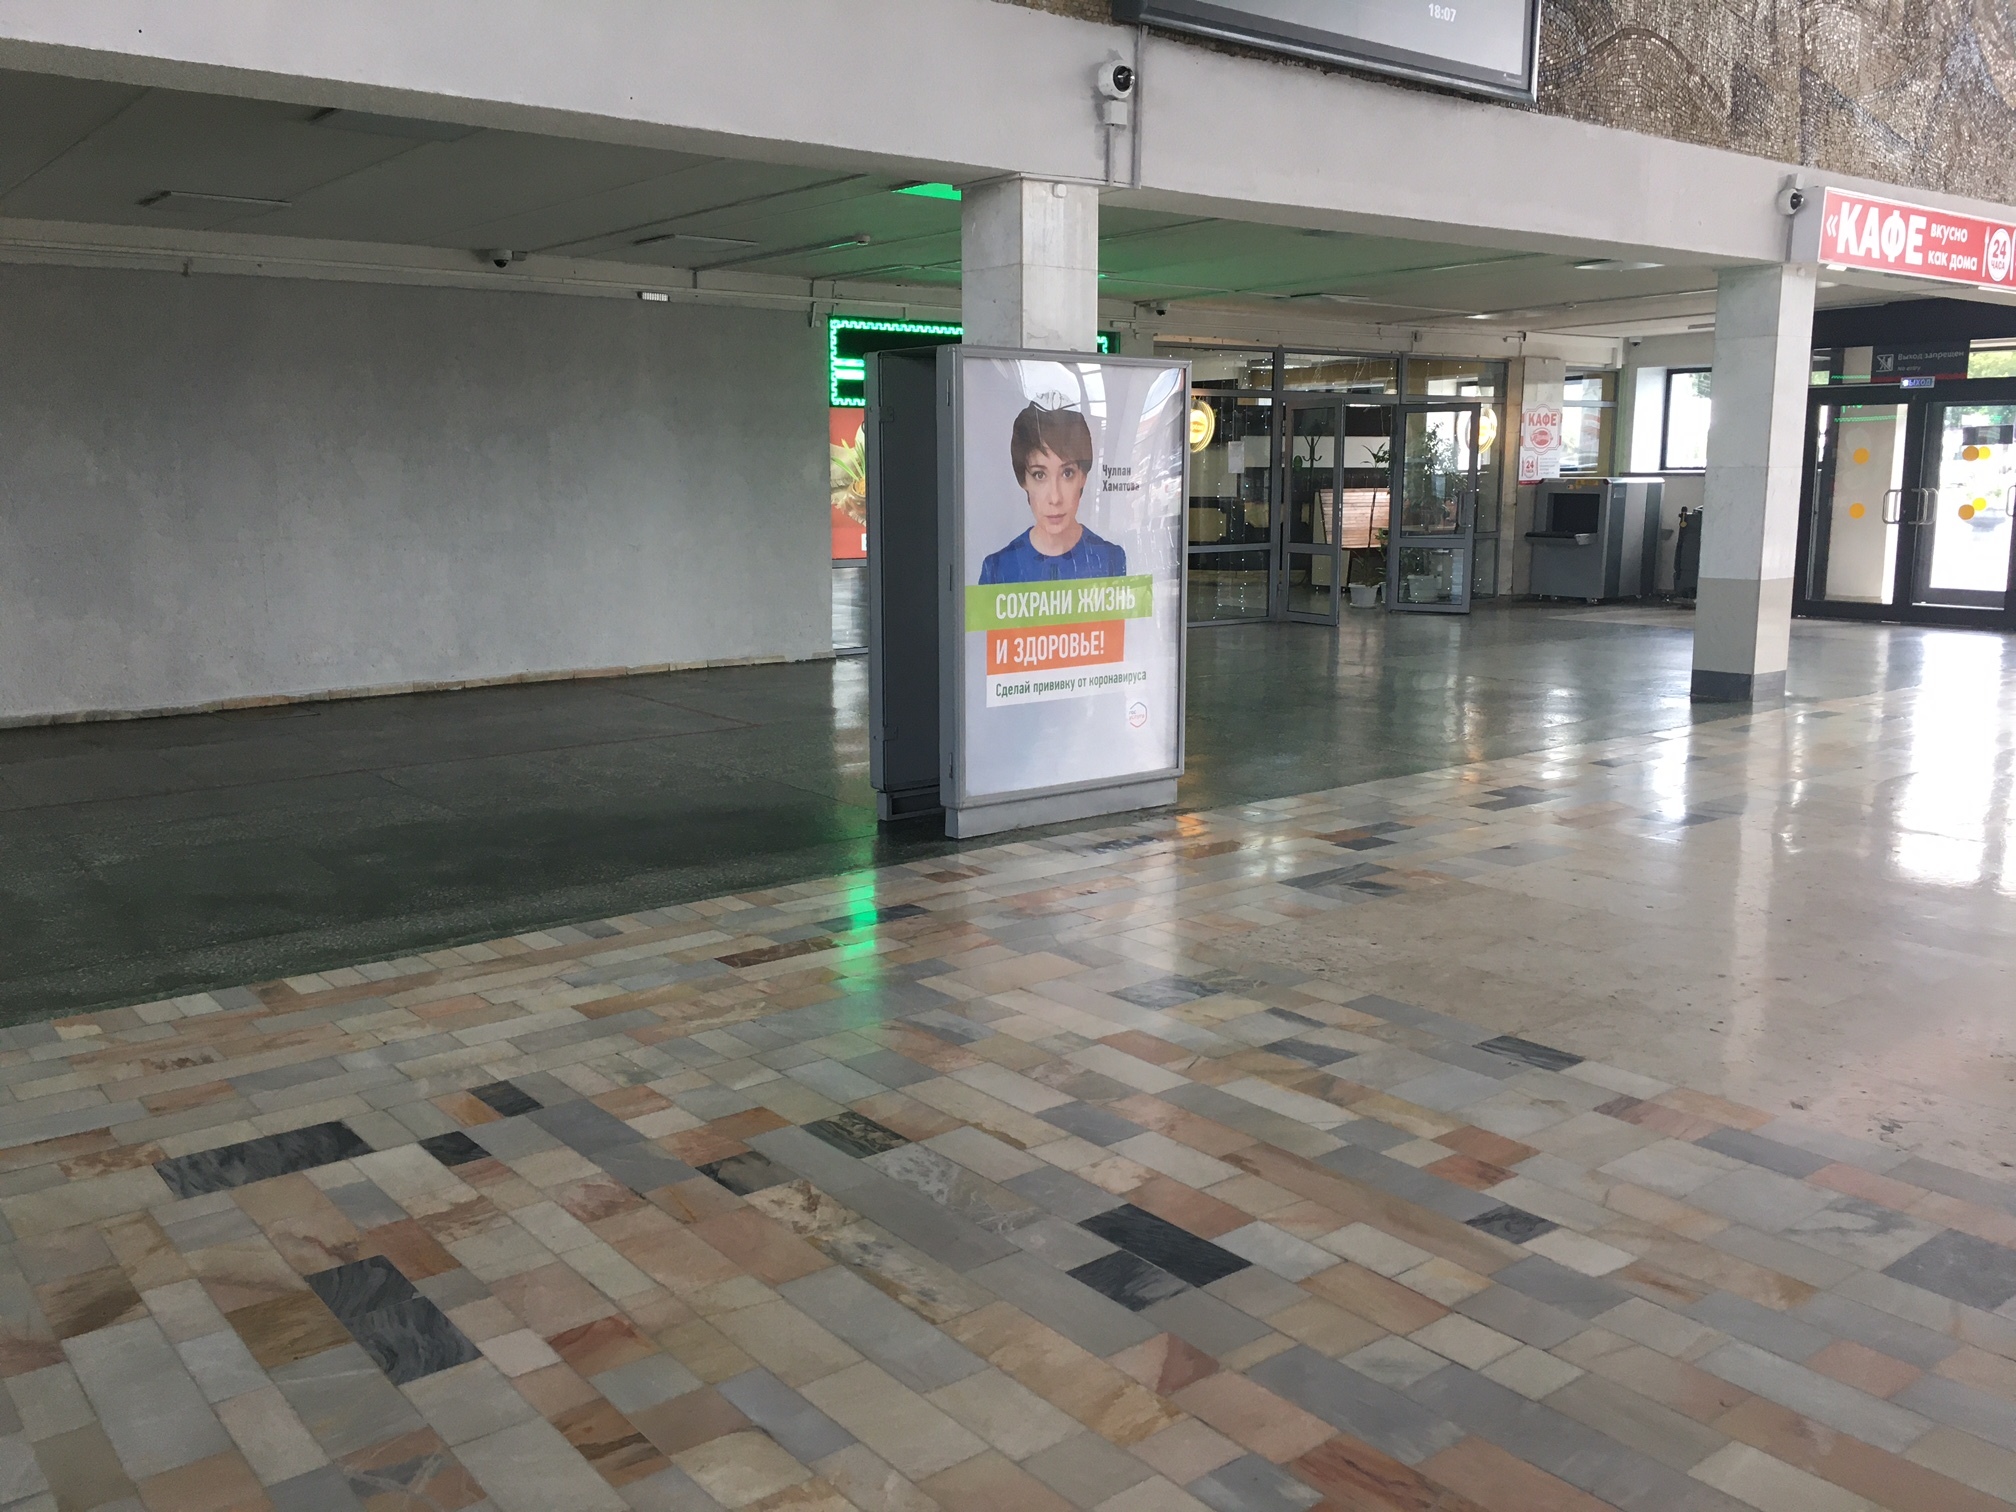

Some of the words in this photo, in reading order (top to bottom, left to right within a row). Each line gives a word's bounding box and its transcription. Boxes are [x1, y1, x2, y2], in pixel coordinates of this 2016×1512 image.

[1428, 3, 1457, 22] 18:07
[1930, 223, 1968, 245] вкусно
[1992, 239, 2007, 259] 24
[1928, 250, 1948, 266] как
[1949, 255, 1978, 271] дома
[1990, 260, 2006, 271] ЧАСА
[1897, 353, 1923, 361] Выход
[1902, 378, 1931, 387] ЫХОД
[1528, 413, 1557, 426] КАФЕ
[1102, 464, 1132, 479] Чулпан
[1526, 460, 1535, 469] 24
[1102, 480, 1140, 492] Хаматова
[996, 589, 1072, 619] СОХРАНИ
[1077, 586, 1135, 613] ЖИЗНЬ
[996, 639, 1008, 665] И
[1013, 631, 1105, 667] ЗДОРОВЬЕ!
[996, 681, 1030, 698] Сделай
[1033, 678, 1075, 696] прививку
[1077, 677, 1087, 688] от
[1090, 671, 1147, 687] коронавируса
